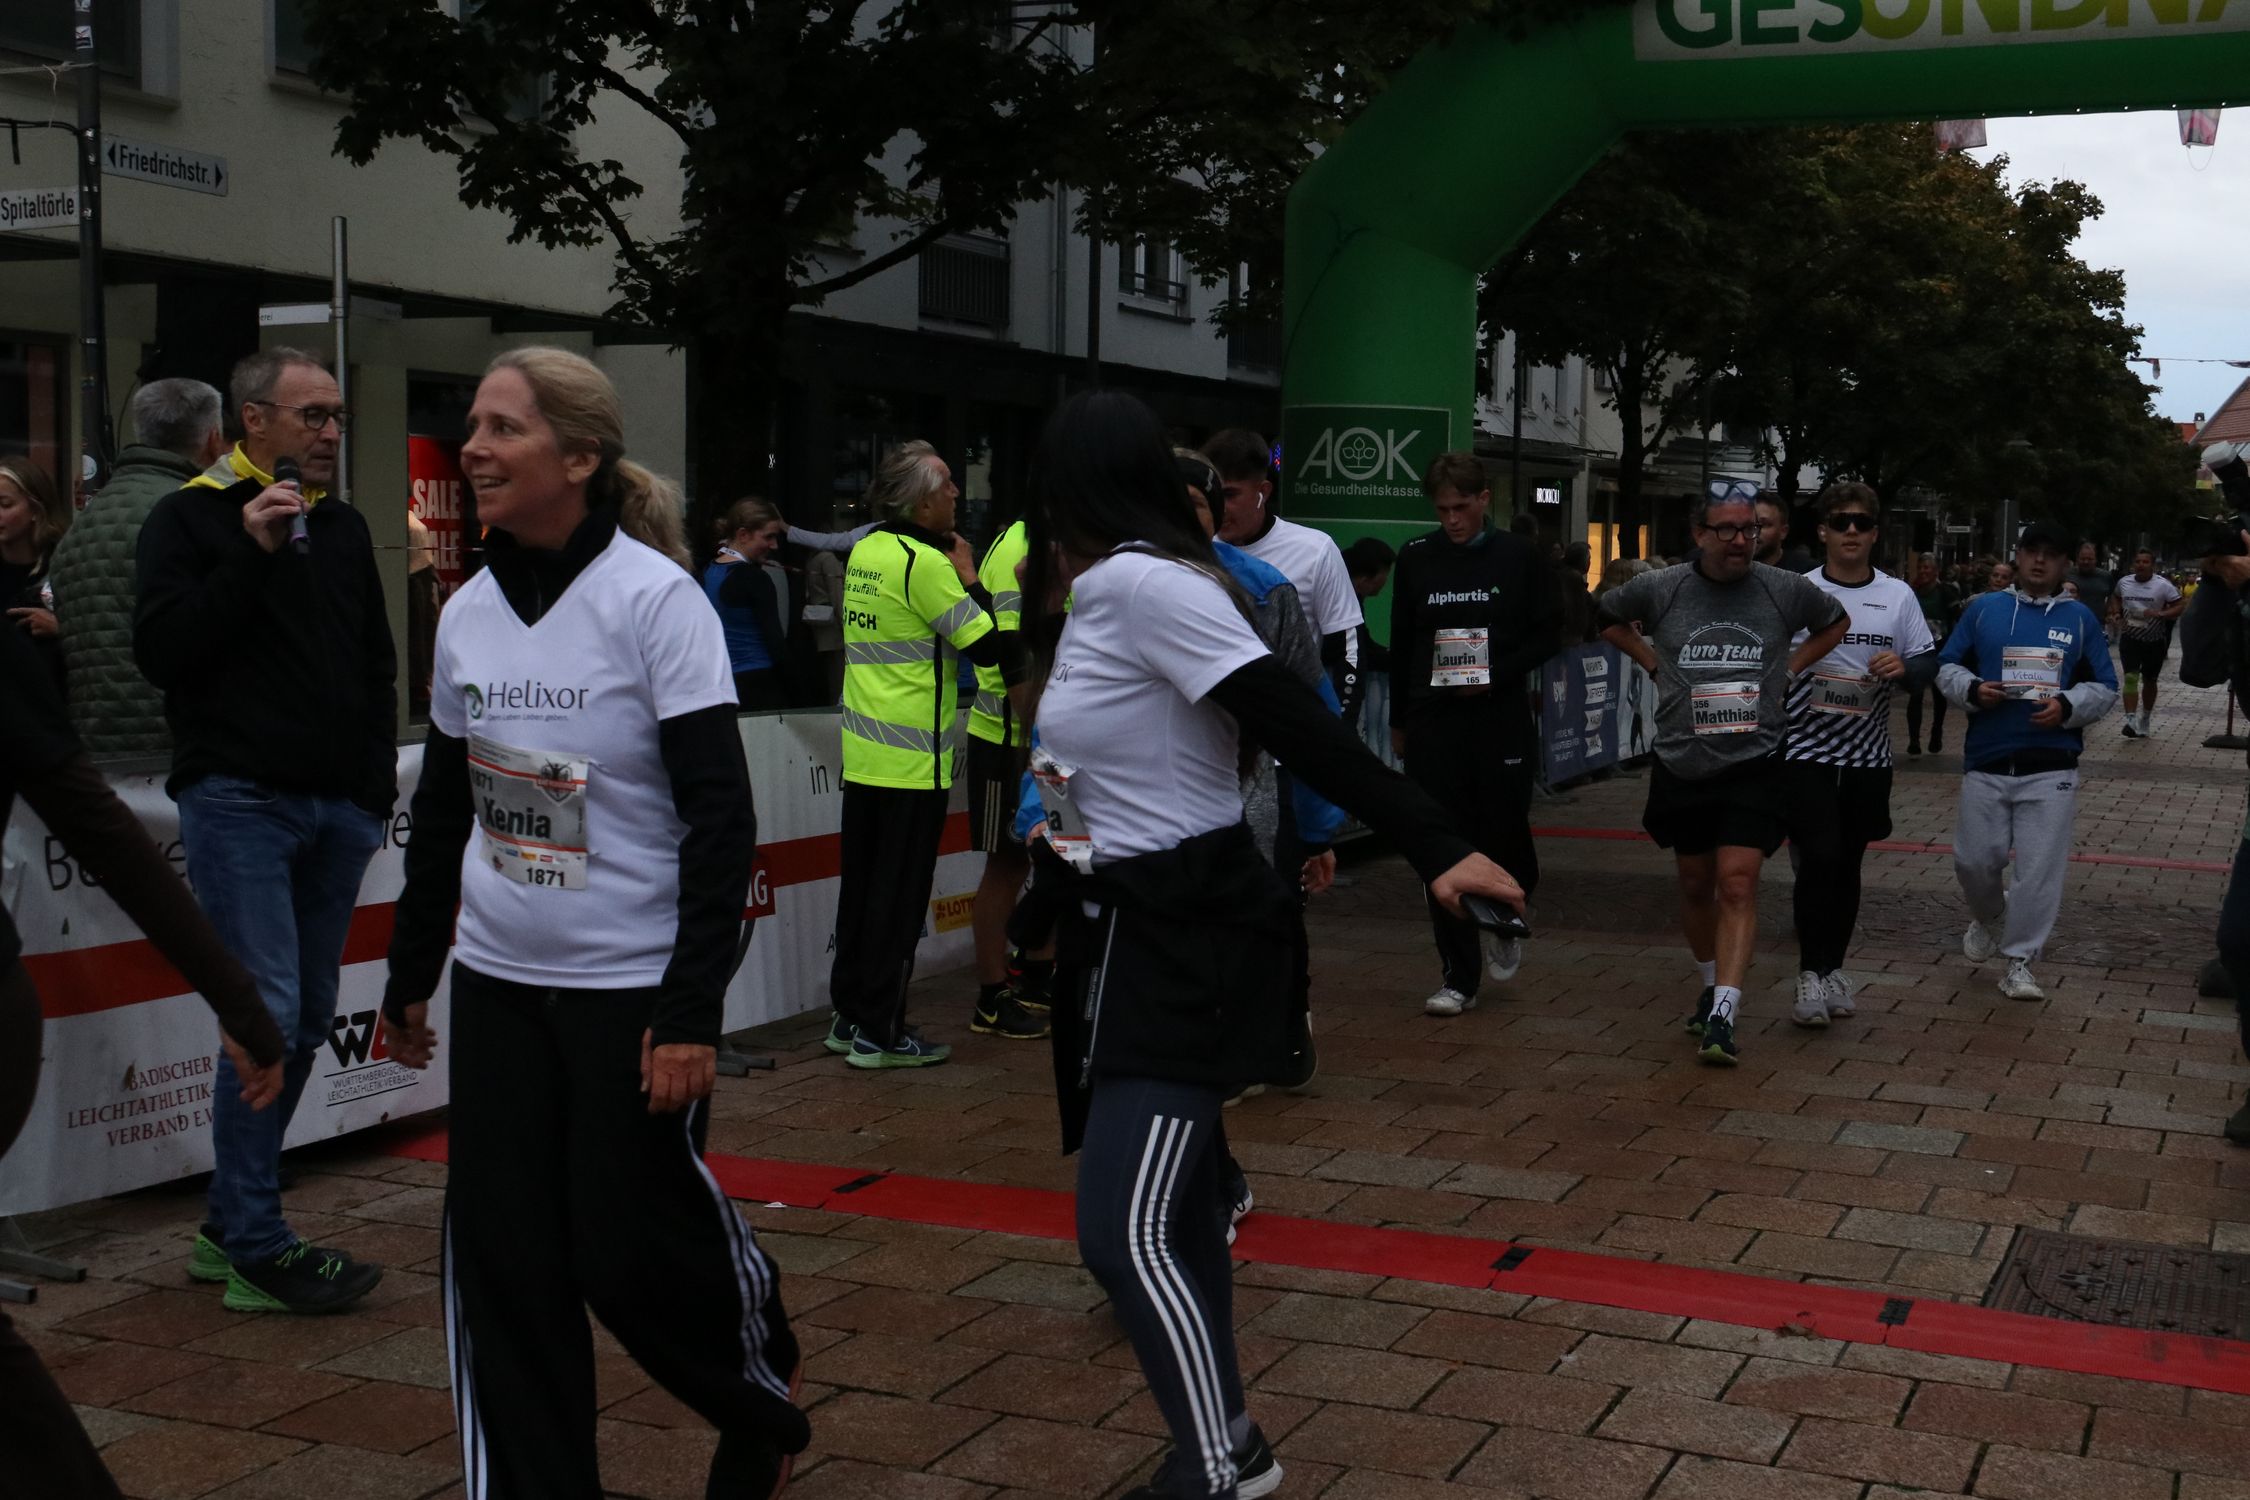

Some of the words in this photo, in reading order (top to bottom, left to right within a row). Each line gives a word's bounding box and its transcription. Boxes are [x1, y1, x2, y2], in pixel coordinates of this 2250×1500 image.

[120, 145, 211, 185] Friedrichstr.
[1, 192, 74, 226] Spitaltörle
[1297, 426, 1422, 481] AOK
[413, 478, 460, 520] SALE
[1294, 482, 1309, 494] Die
[1310, 483, 1424, 497] Gesundheitskasse.
[428, 530, 460, 570] ALE
[1427, 588, 1490, 605] Alphartis
[848, 610, 877, 630] PCH
[1438, 652, 1476, 666] Laurin
[1679, 643, 1763, 663] AUTO-TEAM
[488, 680, 589, 709] Helixor
[1466, 676, 1480, 684] 165
[1693, 700, 1709, 709] 356
[1824, 690, 1859, 707] Noah
[1695, 708, 1756, 724] Matthias
[809, 756, 829, 795] in
[483, 796, 551, 838] Xenia
[526, 867, 565, 887] 1871
[127, 1055, 213, 1091] BADISCHER
[68, 1082, 215, 1129] LEICHTATHLETIK-
[107, 1114, 189, 1147] VERBAND
